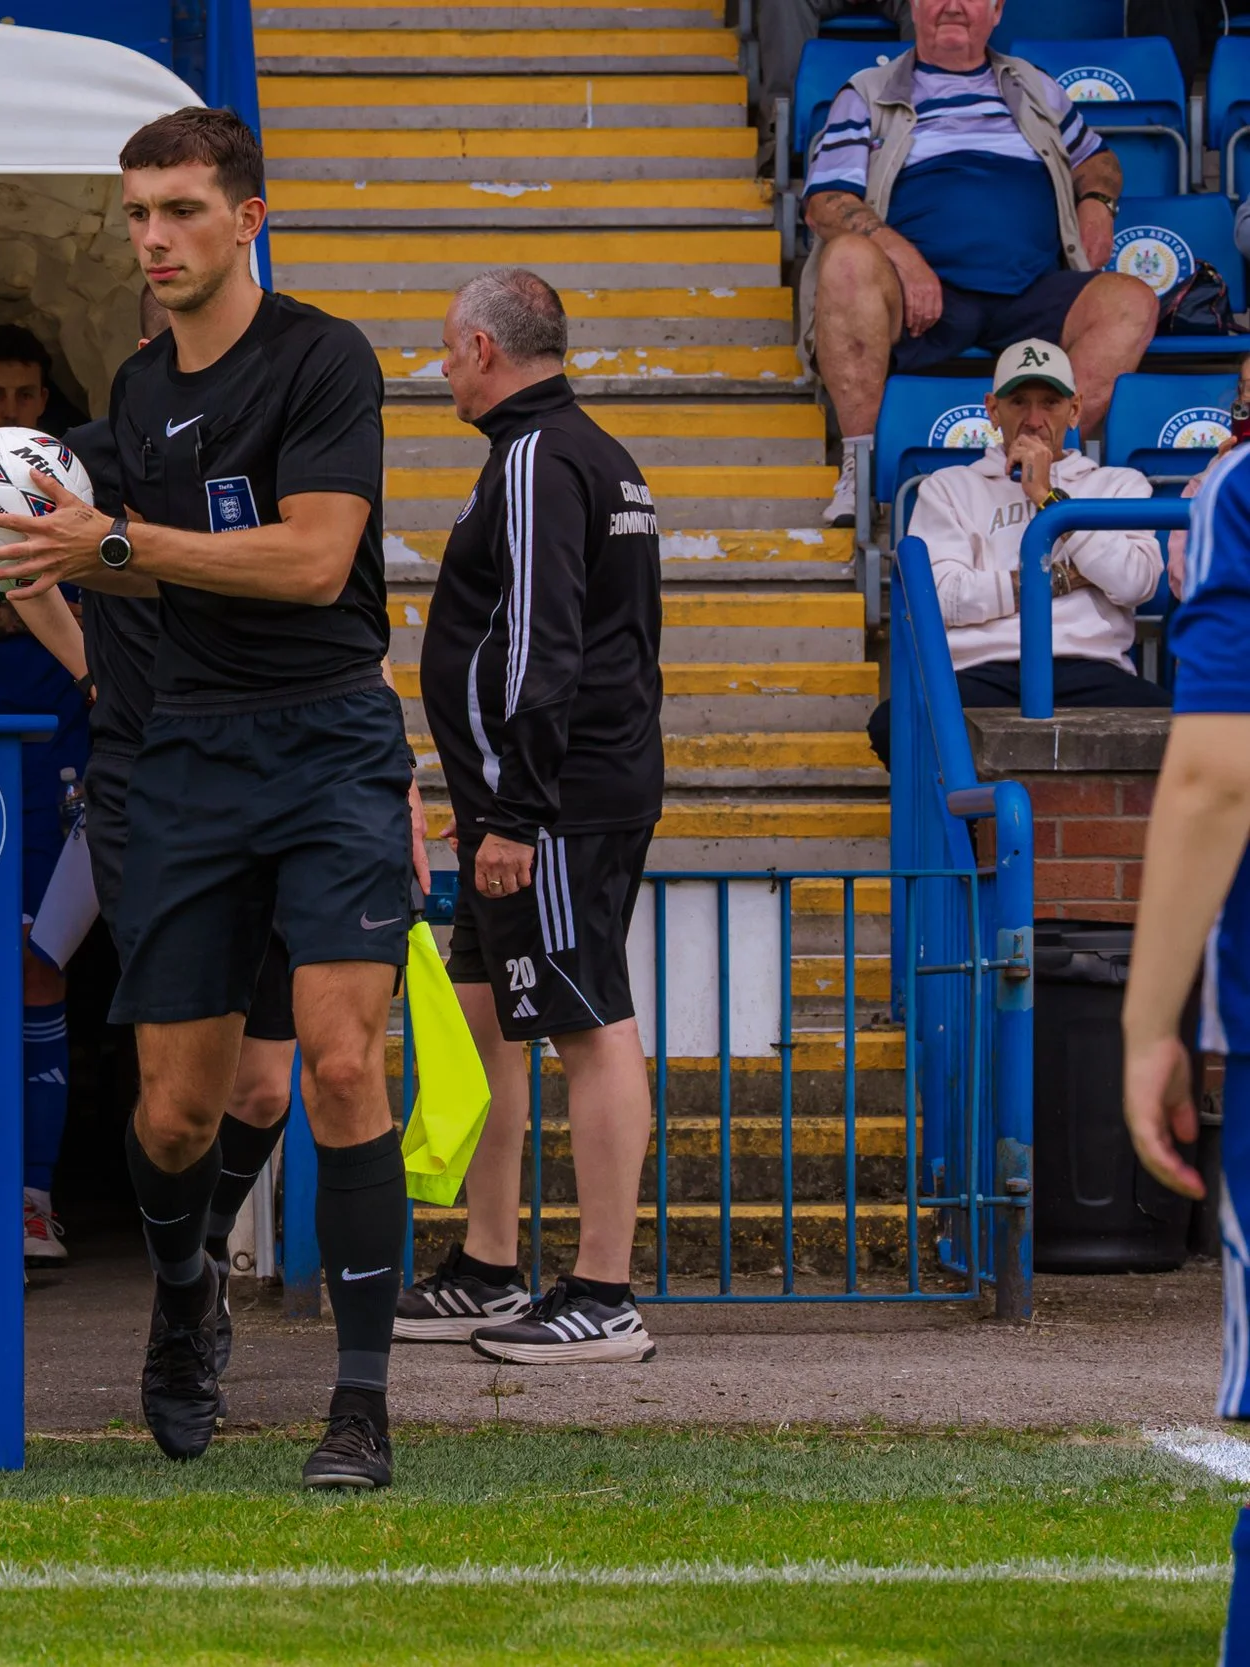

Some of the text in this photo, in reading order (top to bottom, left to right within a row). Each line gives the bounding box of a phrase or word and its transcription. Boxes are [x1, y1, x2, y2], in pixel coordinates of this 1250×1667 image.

[1149, 230, 1187, 260] ASHTON
[934, 409, 970, 441] CURZON
[1163, 412, 1233, 445] CURZON ASHT
[506, 956, 536, 991] 20
